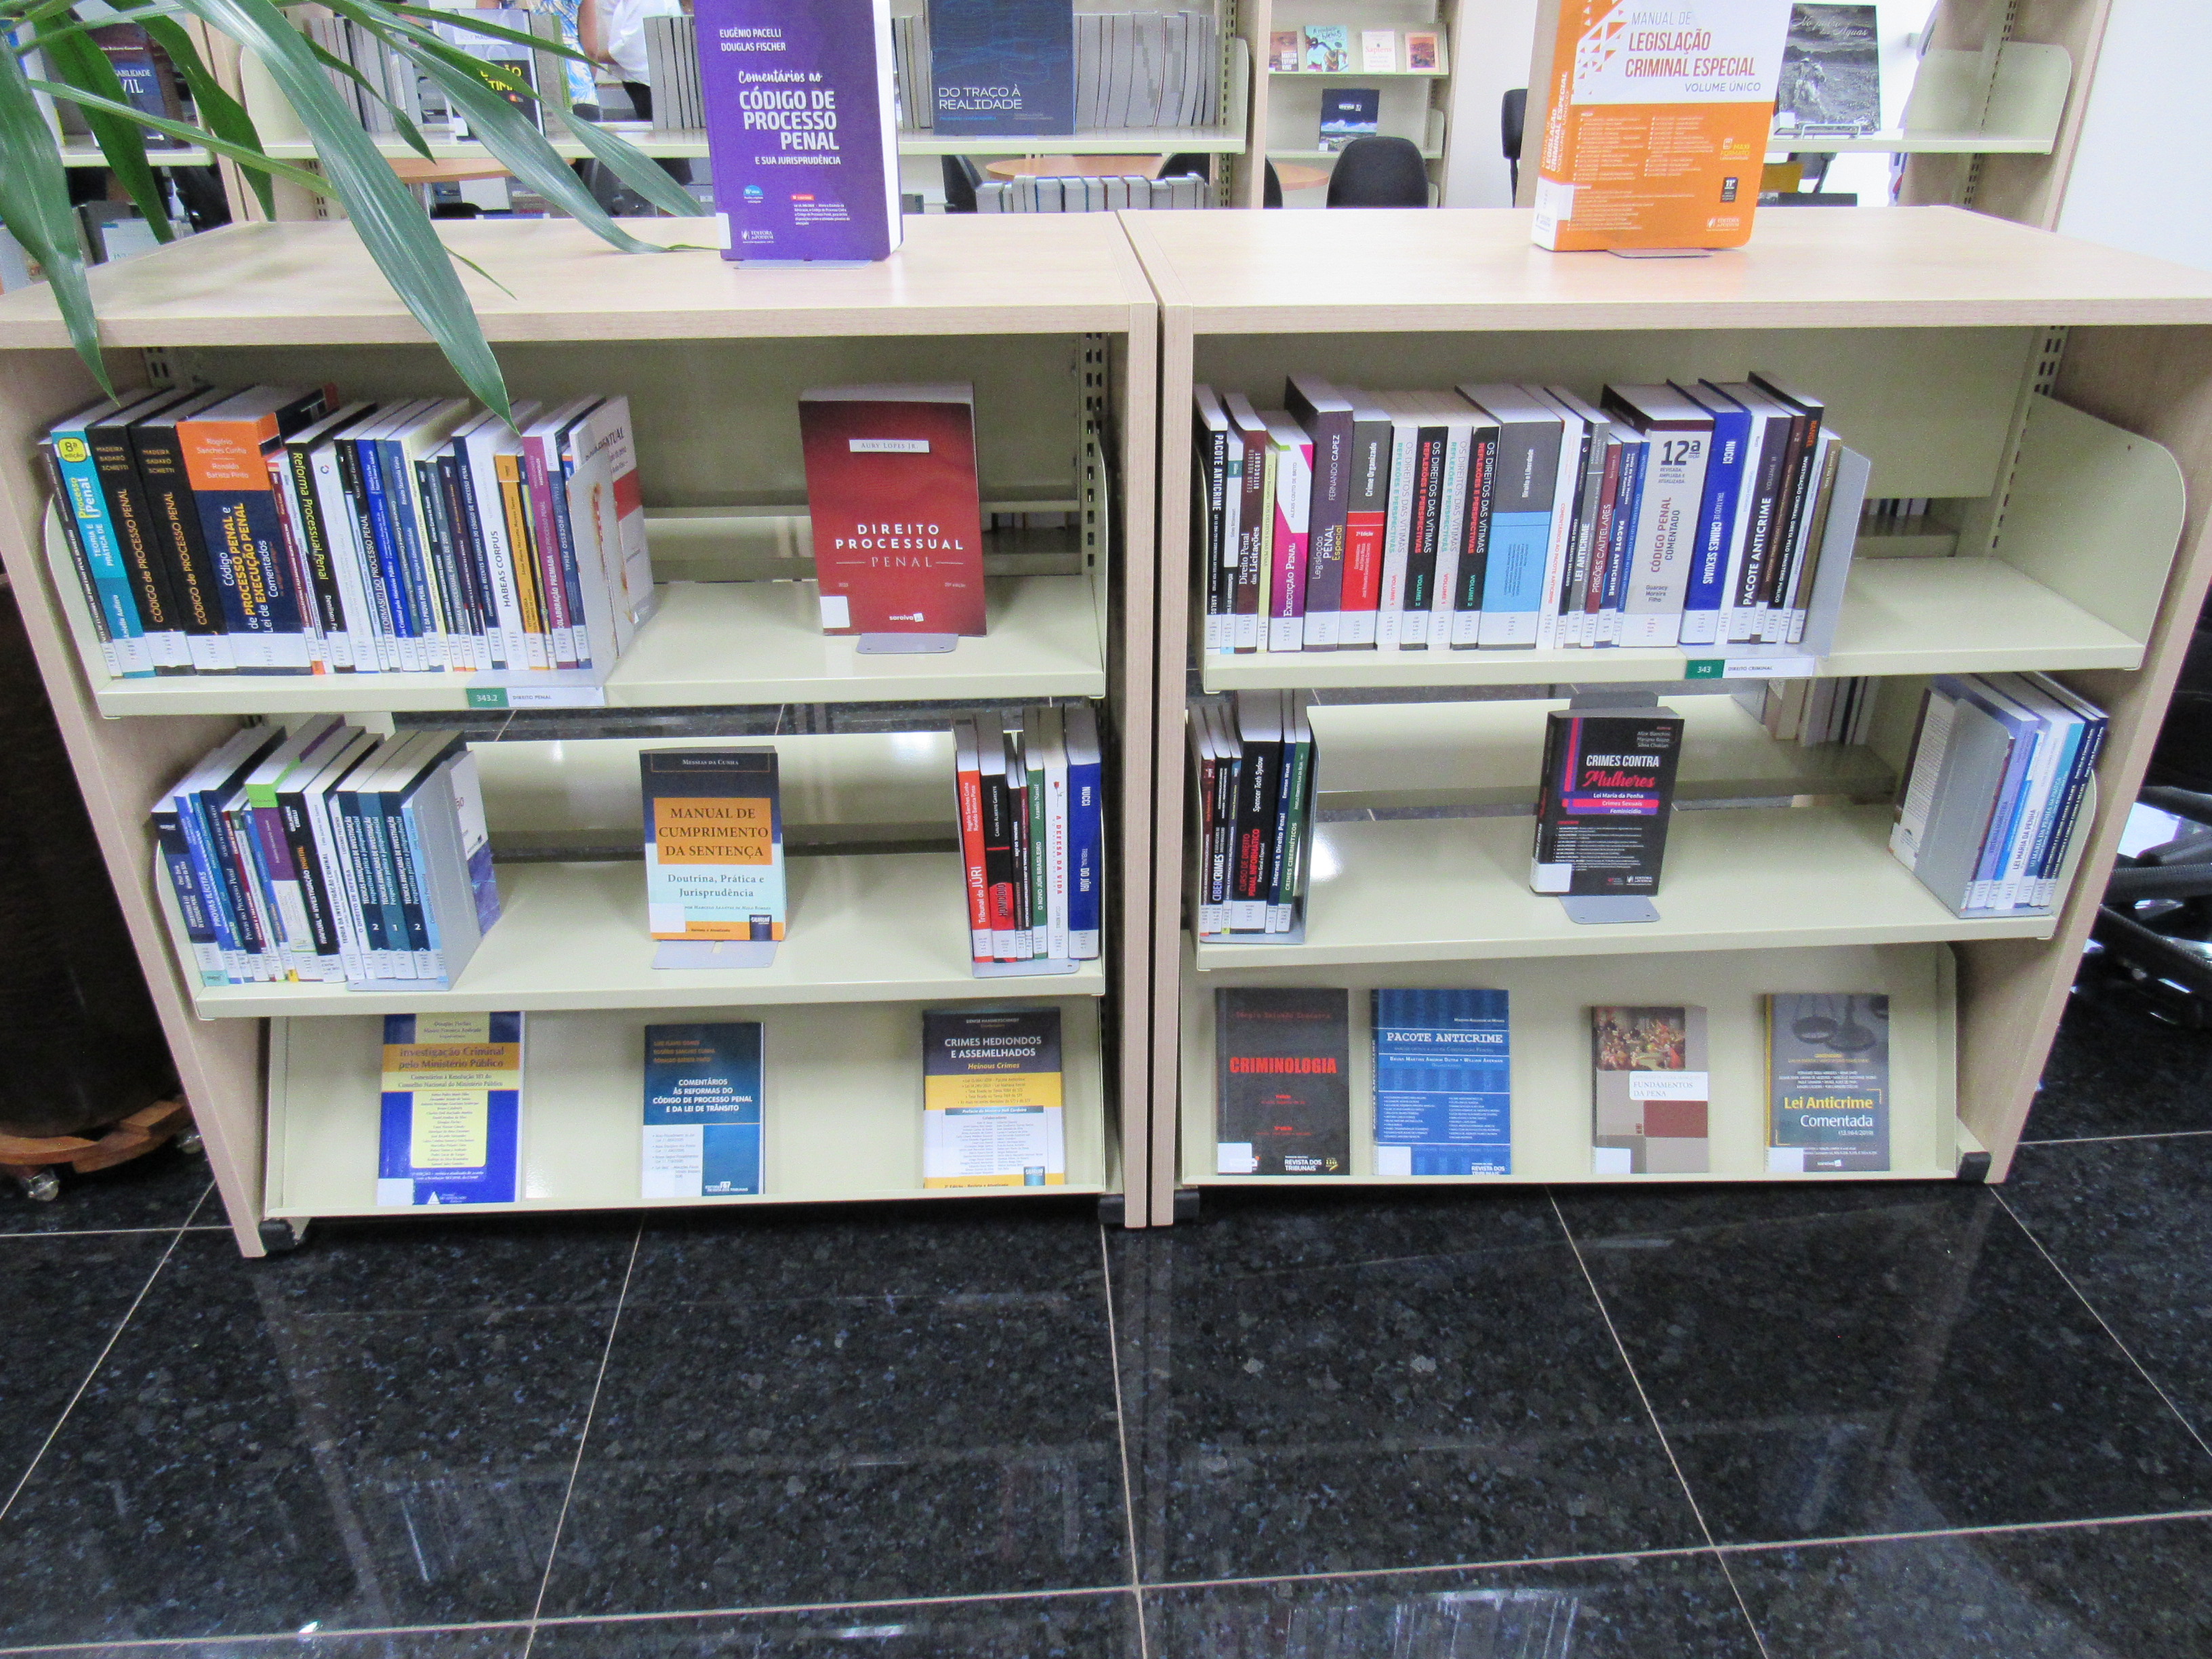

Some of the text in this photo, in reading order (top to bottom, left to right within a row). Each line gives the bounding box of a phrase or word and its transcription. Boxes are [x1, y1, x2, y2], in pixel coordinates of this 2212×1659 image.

[1631, 12, 1692, 25] MANUAL DE
[720, 28, 781, 38] EUGÊNIO PACELLI
[1629, 29, 1711, 55] LEGISLAÇÃO
[721, 42, 786, 52] DOUGLAS FISCHER
[739, 69, 805, 83] Comentários
[1625, 58, 1755, 77] CRIMINAL ESPECIAL
[939, 84, 1021, 98] DO TRAÇO À
[1685, 81, 1760, 92] VOLUME ÚNICO
[739, 86, 836, 109] CÓDIGO DE
[939, 100, 1022, 110] REALIDADE
[743, 111, 836, 129] PROCESSO
[781, 132, 840, 150] PENAL
[778, 155, 841, 165] JURISPRUDÊNCIA
[1805, 421, 1818, 447] RANGEL
[65, 442, 77, 451] 8ª
[1214, 435, 1223, 466] PACOTE
[1660, 441, 1700, 466] 12ª
[1723, 441, 1736, 464] NUCCI
[1329, 435, 1340, 501] FERNANDO CAPEZ
[1366, 443, 1376, 497] Crime Organizado
[70, 478, 85, 518] Processo
[78, 477, 102, 518] Penal
[1212, 468, 1222, 511] ANTICRIME
[1424, 443, 1440, 553] OS DIREITOS DAS VÍTIMAS
[293, 453, 329, 580] Reforma Processual Penal
[223, 516, 241, 553] PENAL
[857, 525, 939, 535] DIREITO
[1652, 497, 1671, 572] CÓDIGO PENAL
[1665, 510, 1680, 560] COMENTADO
[836, 539, 964, 550] PROCESSUAL
[1250, 527, 1259, 571] Licitações
[1323, 525, 1334, 558] PENAL
[1332, 525, 1343, 560] Especial
[1743, 497, 1771, 605] PACOTE ANTICRIME
[872, 557, 933, 568] PENAL
[1312, 537, 1324, 579] Legislação
[1703, 523, 1722, 584] CRIMES SEXUAIS
[220, 552, 234, 586] Código
[236, 503, 274, 632] Lei de EXECUÇÃO PENAL
[258, 540, 279, 598] Comentados
[490, 531, 511, 607] HABEAS CORPUS
[1239, 556, 1248, 585] Direito
[233, 556, 255, 615] PROCESSO
[249, 617, 259, 629] de
[1586, 755, 1659, 767] CRIMES CONTRA
[1582, 771, 1656, 787] Mulheres
[1082, 787, 1090, 806] NUCCI
[1253, 789, 1261, 812] Spencer
[670, 808, 756, 818] MANUAL DE
[659, 827, 769, 838] CUMPRIMENTO
[665, 846, 763, 859] DA SENTENÇA
[668, 874, 718, 884] Doutrina,
[721, 874, 756, 882] Prática
[971, 866, 981, 888] JÚRI
[1212, 855, 1224, 901] CIBERCRIMES
[679, 888, 754, 898] Jurisprudência
[945, 1037, 1042, 1047] CRIMES HEDIONDOS
[1387, 1032, 1502, 1043] PACOTE ANTICRIME
[959, 1048, 1036, 1058] ASSEMELHADOS
[1229, 1057, 1337, 1074] CRIMINOLOGIA
[706, 1103, 739, 1111] TRÂNSITO
[1784, 1097, 1873, 1109] Lei Anticrime
[1800, 1115, 1873, 1127] Comentada
